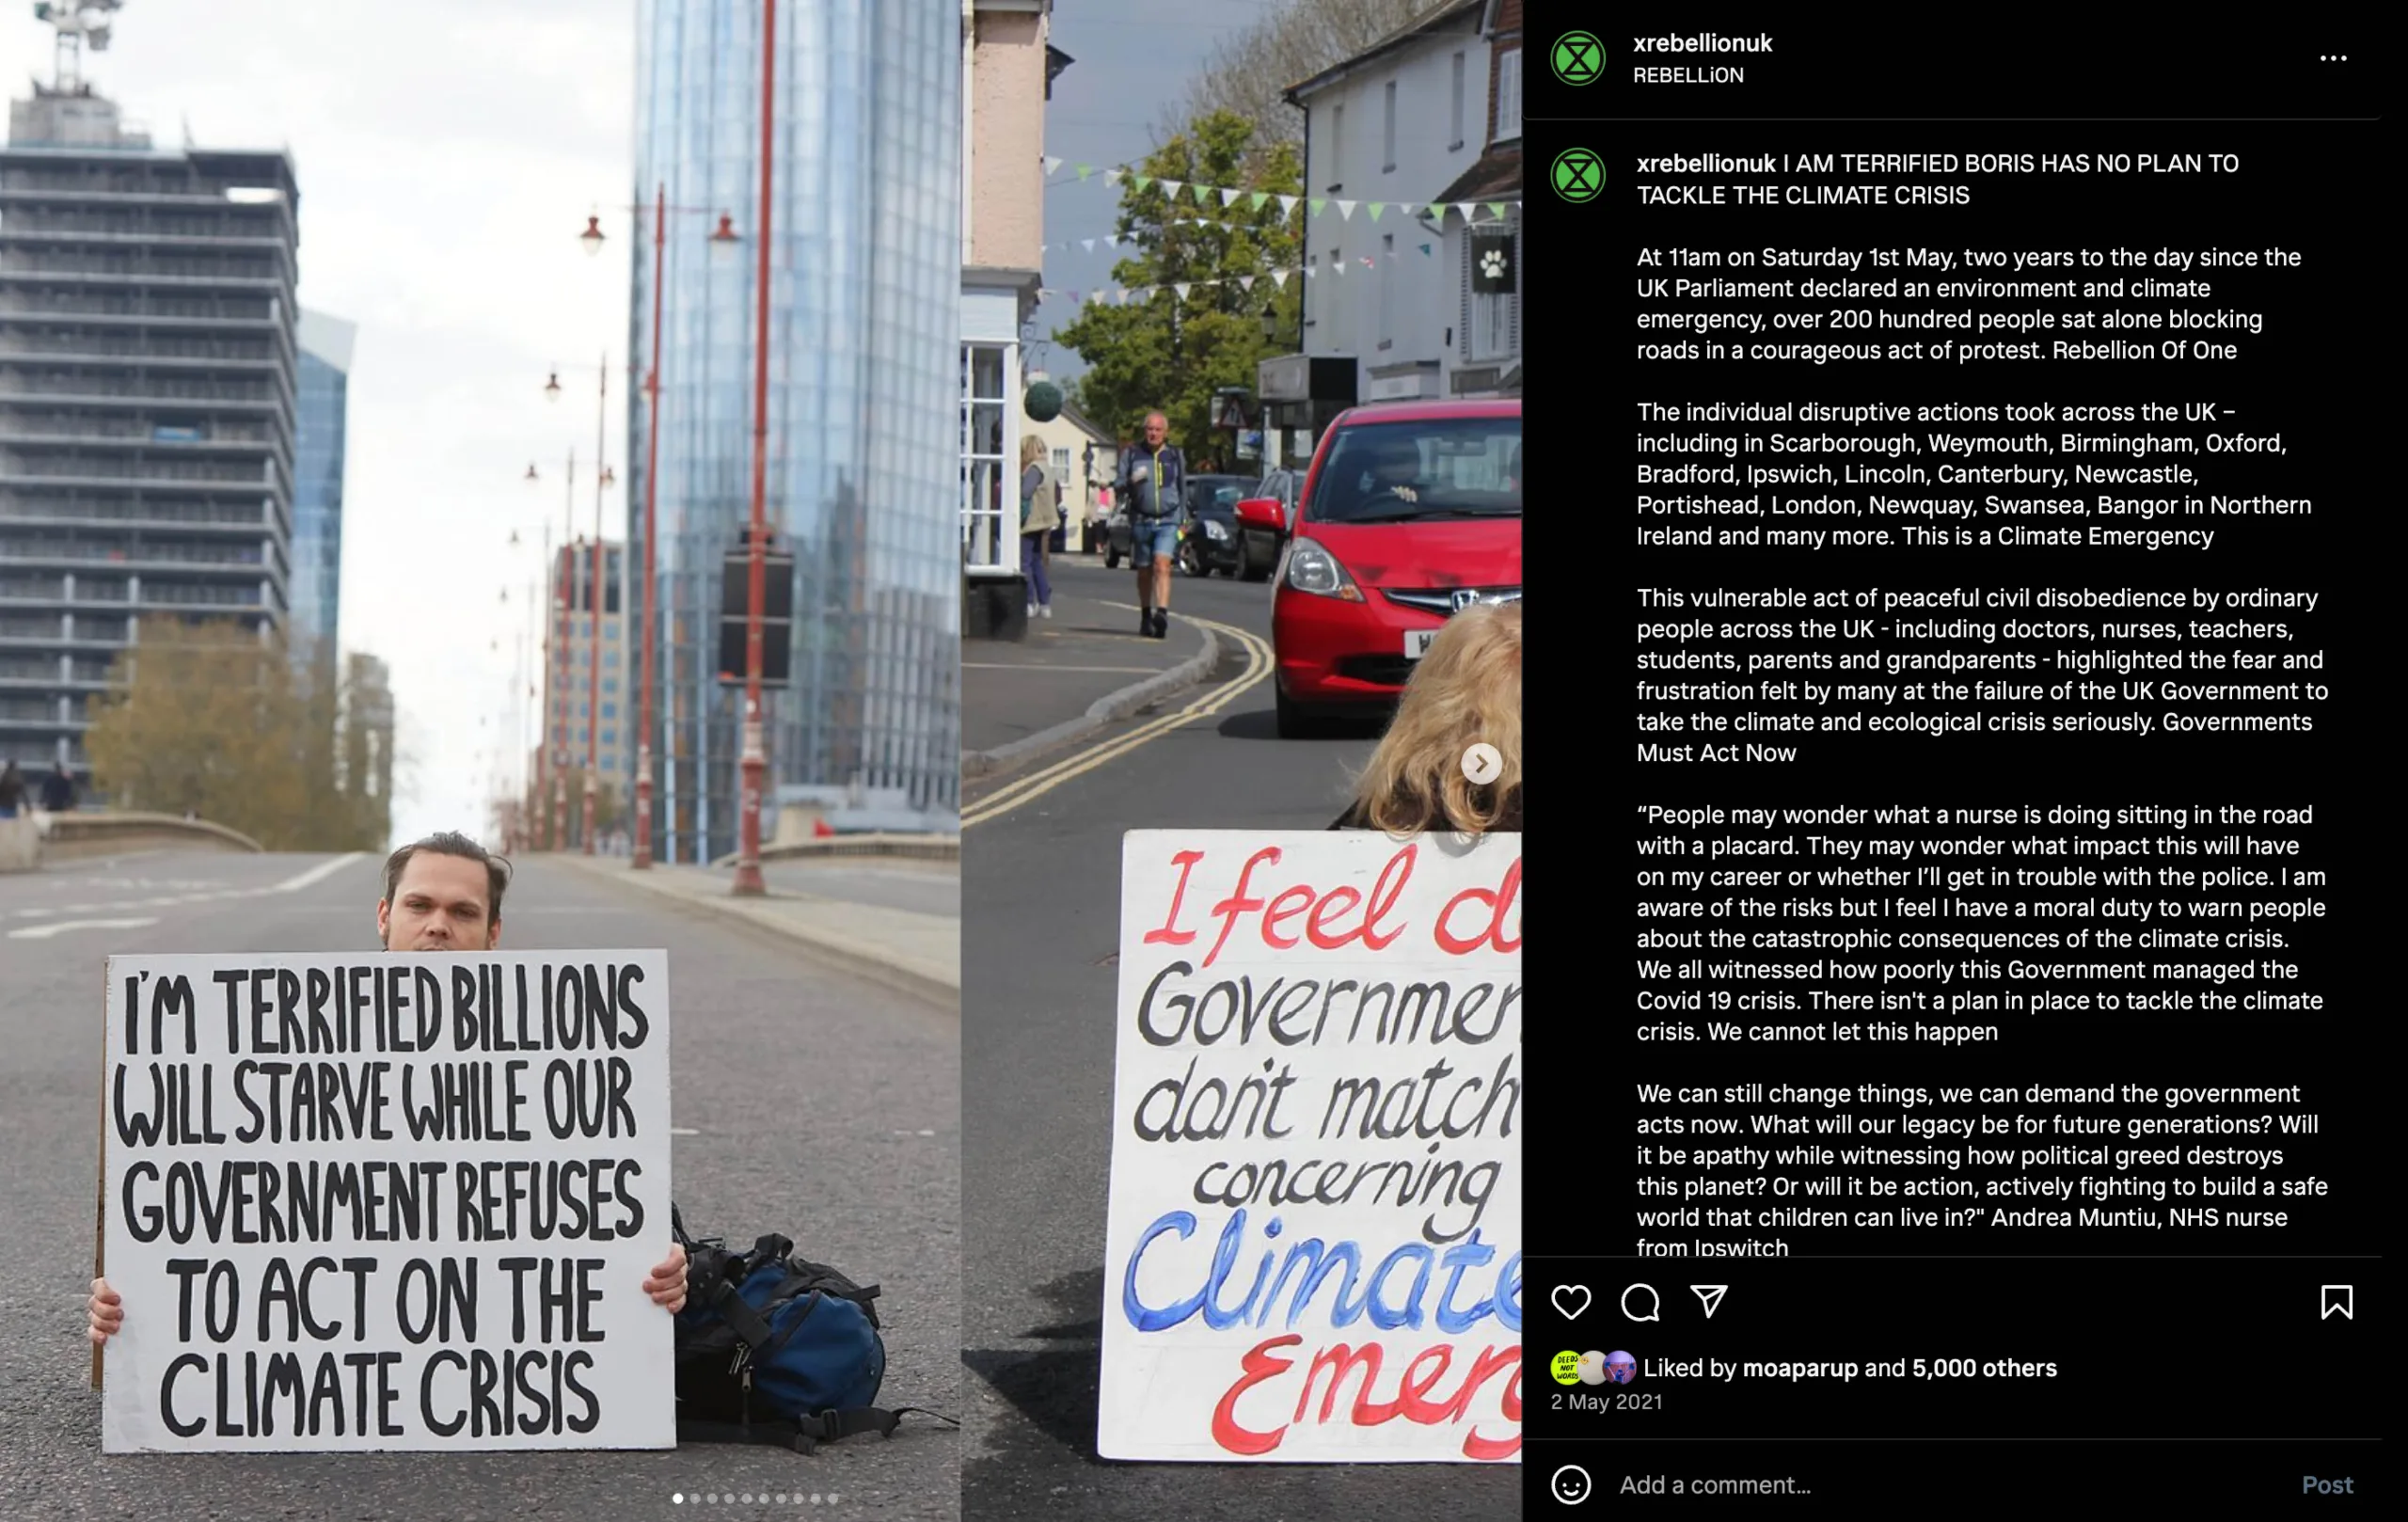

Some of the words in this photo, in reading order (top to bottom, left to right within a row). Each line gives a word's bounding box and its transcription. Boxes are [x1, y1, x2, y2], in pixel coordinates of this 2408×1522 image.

[1143, 849, 1205, 946] I
[1202, 843, 1418, 968] feel
[1434, 856, 1521, 956] d
[125, 970, 197, 1055] I'M
[213, 965, 442, 1054] TERRIFIED
[452, 963, 649, 1053] BILLIONS
[113, 1062, 227, 1149] WILL
[233, 1059, 393, 1144] STARVE
[402, 1059, 531, 1142] WHILE
[544, 1056, 637, 1140] OUR
[1133, 1054, 1298, 1143] don't
[1318, 1052, 1521, 1140] match
[122, 1160, 448, 1245] GOVERNMENT
[455, 1158, 644, 1242] REFUSES
[1193, 1141, 1502, 1245] concerning
[166, 1258, 240, 1343] TO
[257, 1256, 378, 1342] ACT
[396, 1257, 478, 1345] ON
[498, 1257, 606, 1344] THE
[160, 1351, 404, 1438] CLIMATE
[420, 1348, 600, 1438] CRISIS
[1557, 1356, 1578, 1364] DEEDS
